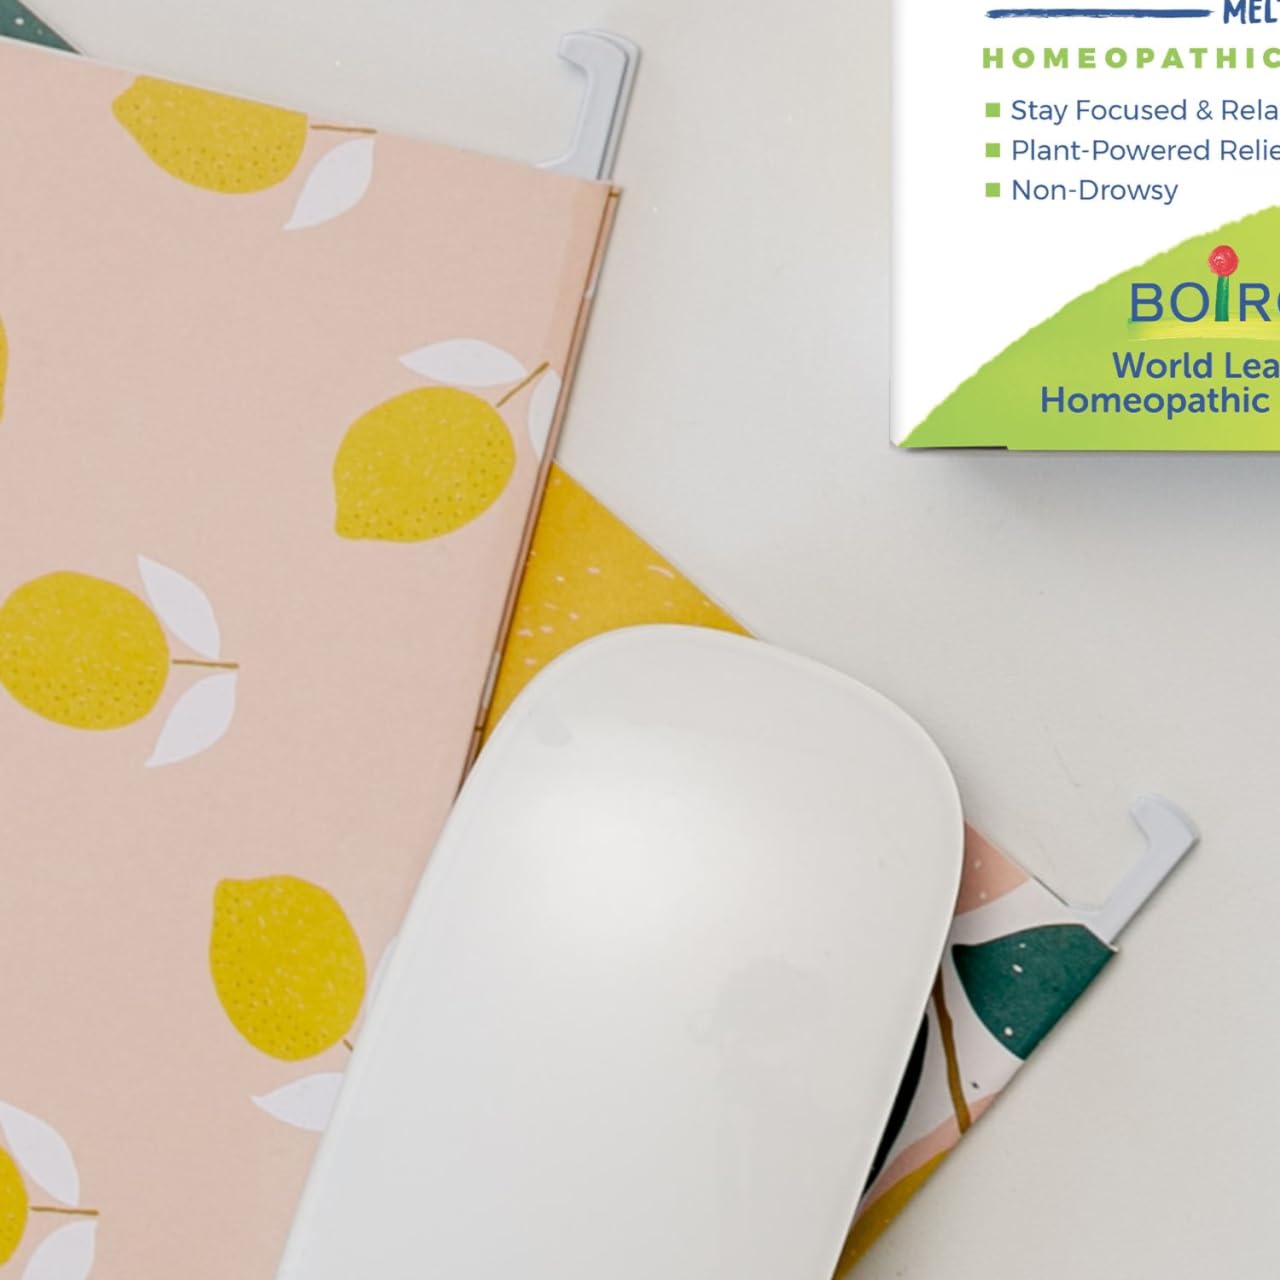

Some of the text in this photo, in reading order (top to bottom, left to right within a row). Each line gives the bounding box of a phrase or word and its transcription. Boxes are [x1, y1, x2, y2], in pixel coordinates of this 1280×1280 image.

[1011, 100, 1068, 125] Stay
[1077, 99, 1186, 120] Focused
[1197, 100, 1213, 120] &
[1013, 139, 1209, 160] Plant-Powered
[1013, 180, 1178, 205] Non-Drowsy
[1112, 352, 1212, 378] World
[1042, 387, 1269, 420] Homeopathic
